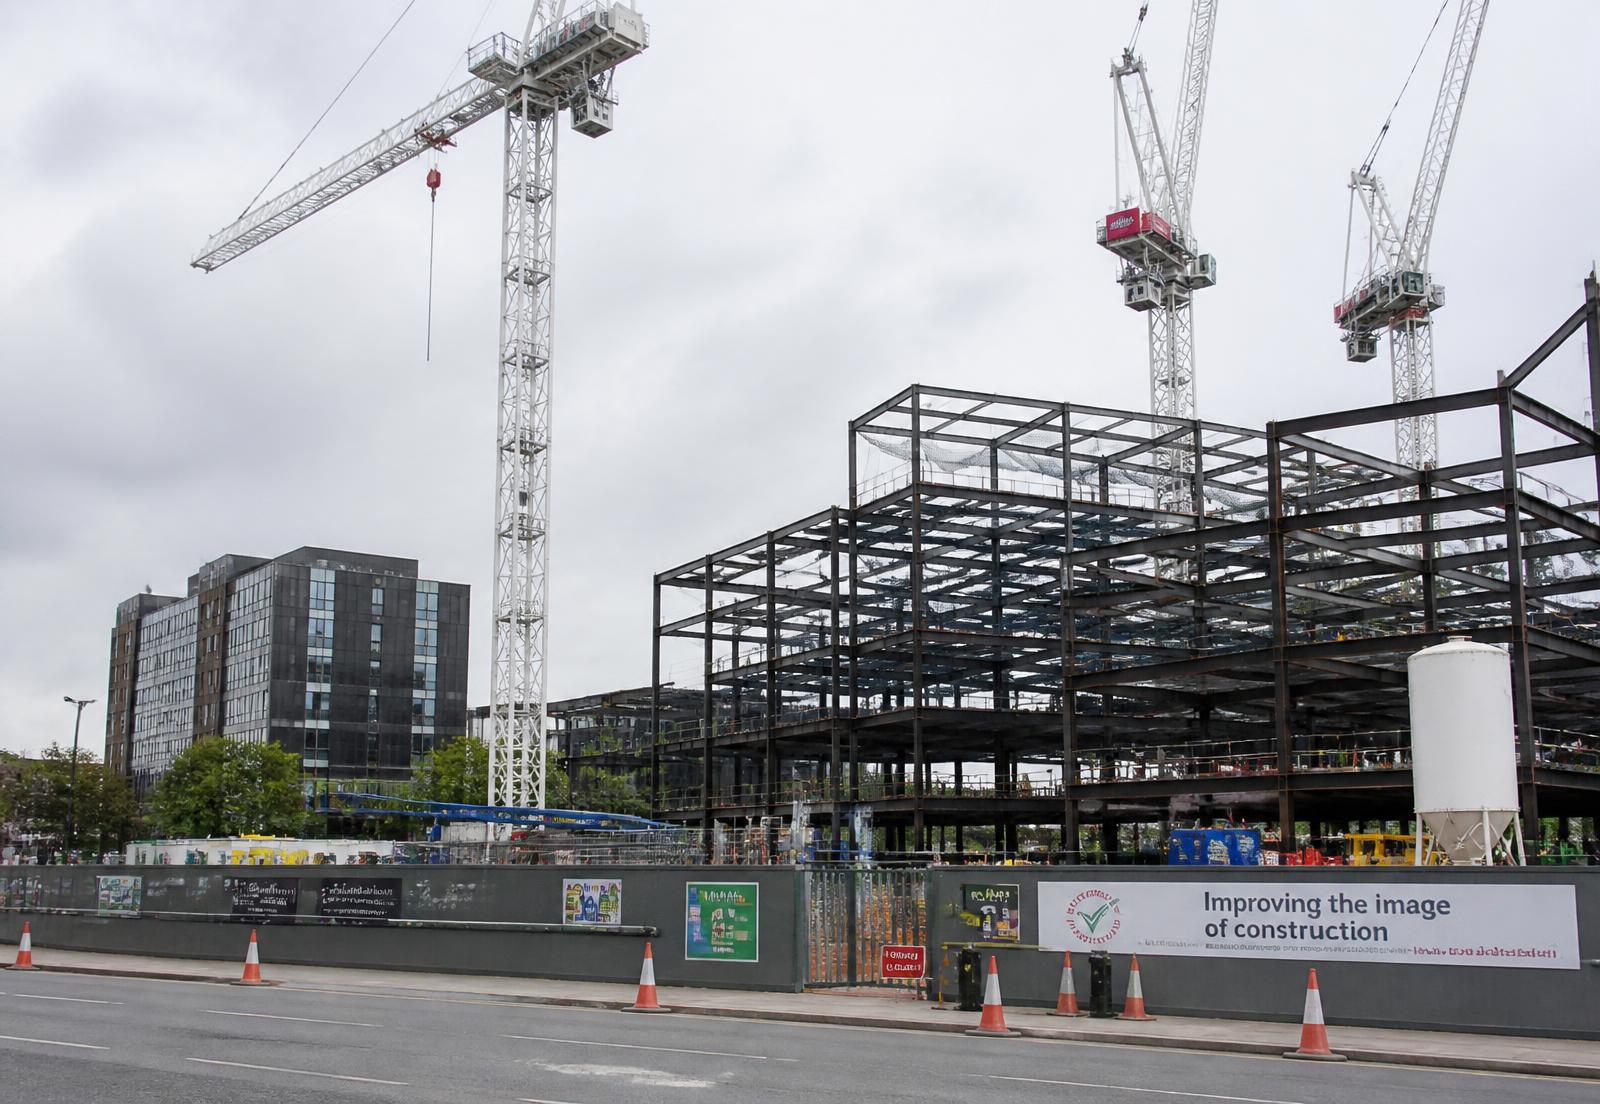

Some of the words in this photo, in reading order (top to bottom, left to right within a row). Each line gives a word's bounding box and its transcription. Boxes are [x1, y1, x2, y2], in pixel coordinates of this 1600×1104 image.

[1204, 891, 1322, 920] Improving
[1327, 892, 1368, 914] the
[1375, 893, 1451, 921] image
[1204, 918, 1229, 938] of
[1234, 920, 1388, 942] construction
